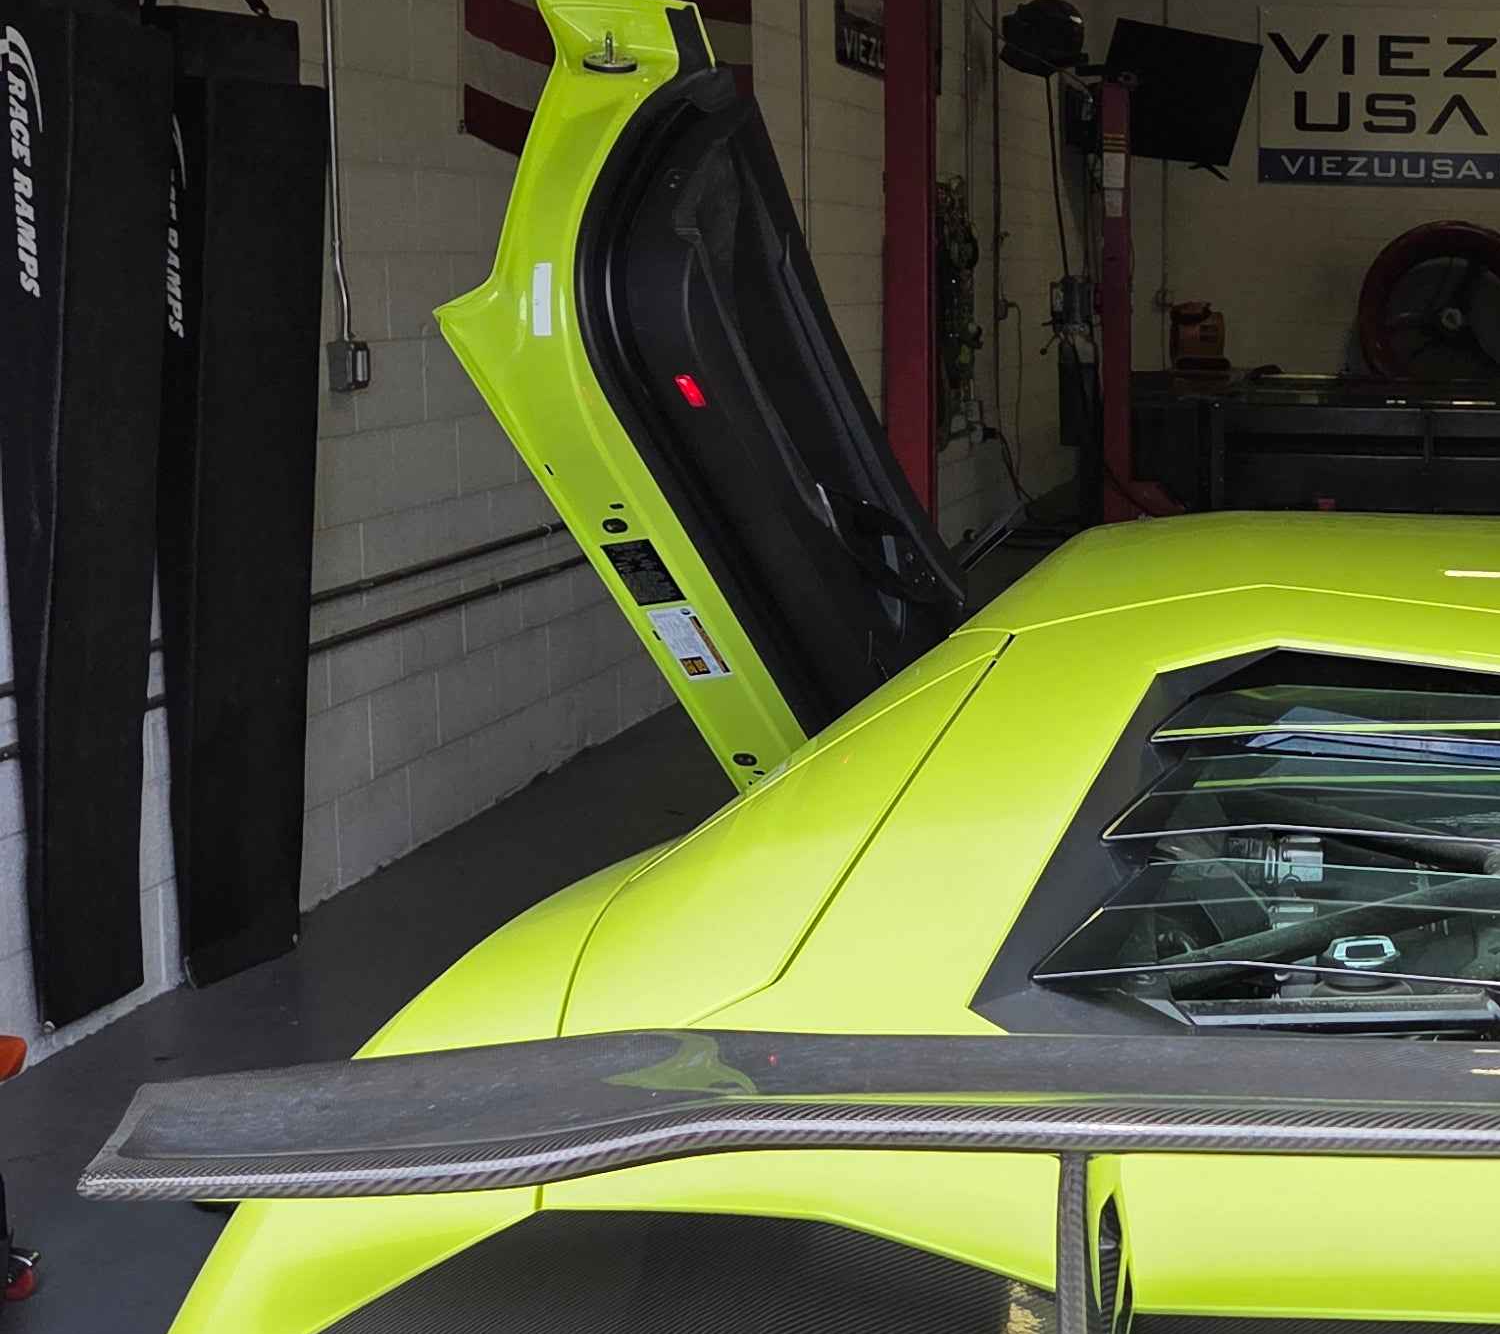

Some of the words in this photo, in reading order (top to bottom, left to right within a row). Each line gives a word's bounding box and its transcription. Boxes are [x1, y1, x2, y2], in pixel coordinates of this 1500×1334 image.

[7, 72, 31, 167] RACE
[1294, 91, 1488, 136] USA
[13, 168, 40, 298] RAMPS
